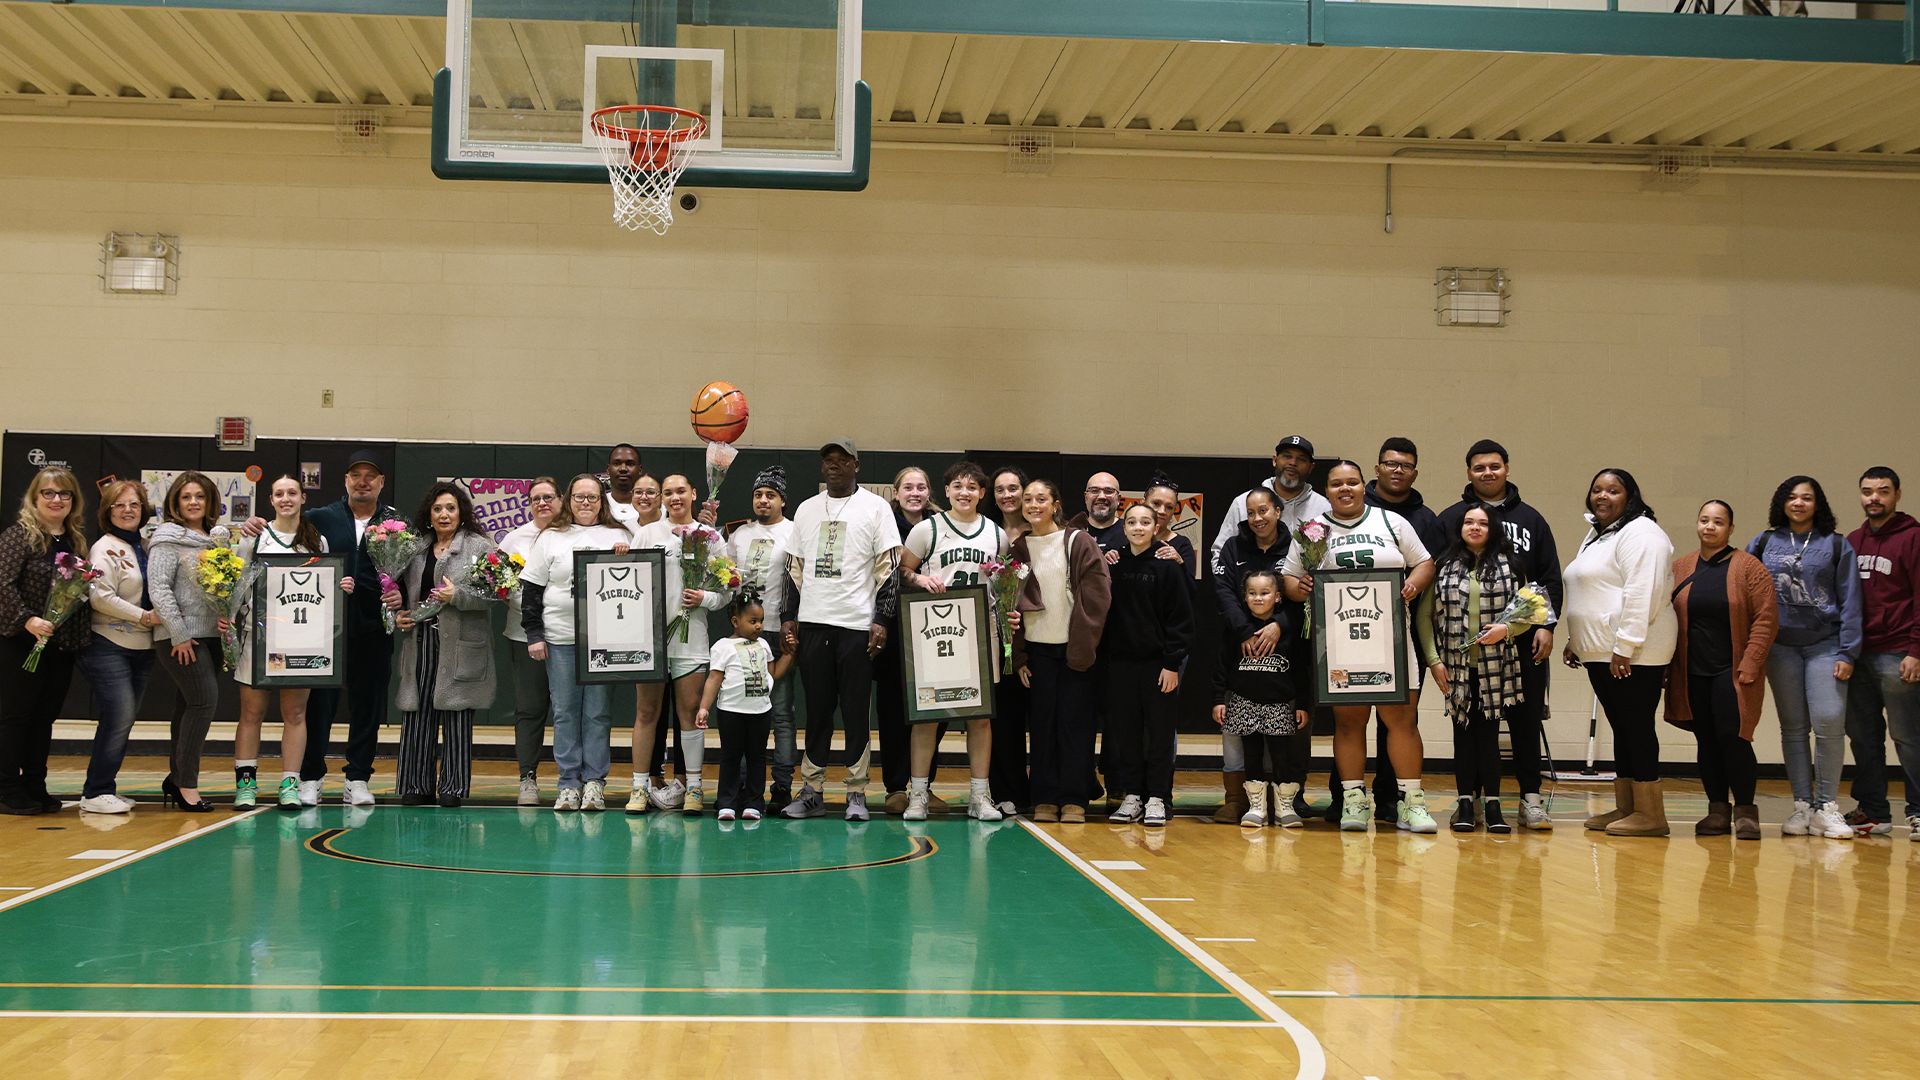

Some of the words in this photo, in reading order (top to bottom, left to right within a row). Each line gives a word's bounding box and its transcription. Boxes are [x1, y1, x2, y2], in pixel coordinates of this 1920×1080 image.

[1292, 436, 1300, 445] B
[470, 479, 531, 494] CAPTAI
[474, 493, 531, 519] anna
[1330, 534, 1386, 549] ICHOLS
[1764, 543, 1832, 560] REDEMPTIO
[280, 593, 322, 606] NICHOLS
[599, 588, 641, 602] NICHOLS
[293, 607, 307, 624] 11
[616, 603, 624, 620] 1
[1337, 608, 1380, 622] NICHOLS
[923, 626, 965, 640] NICHOLS
[1349, 623, 1370, 640] 55
[937, 640, 954, 657] 21
